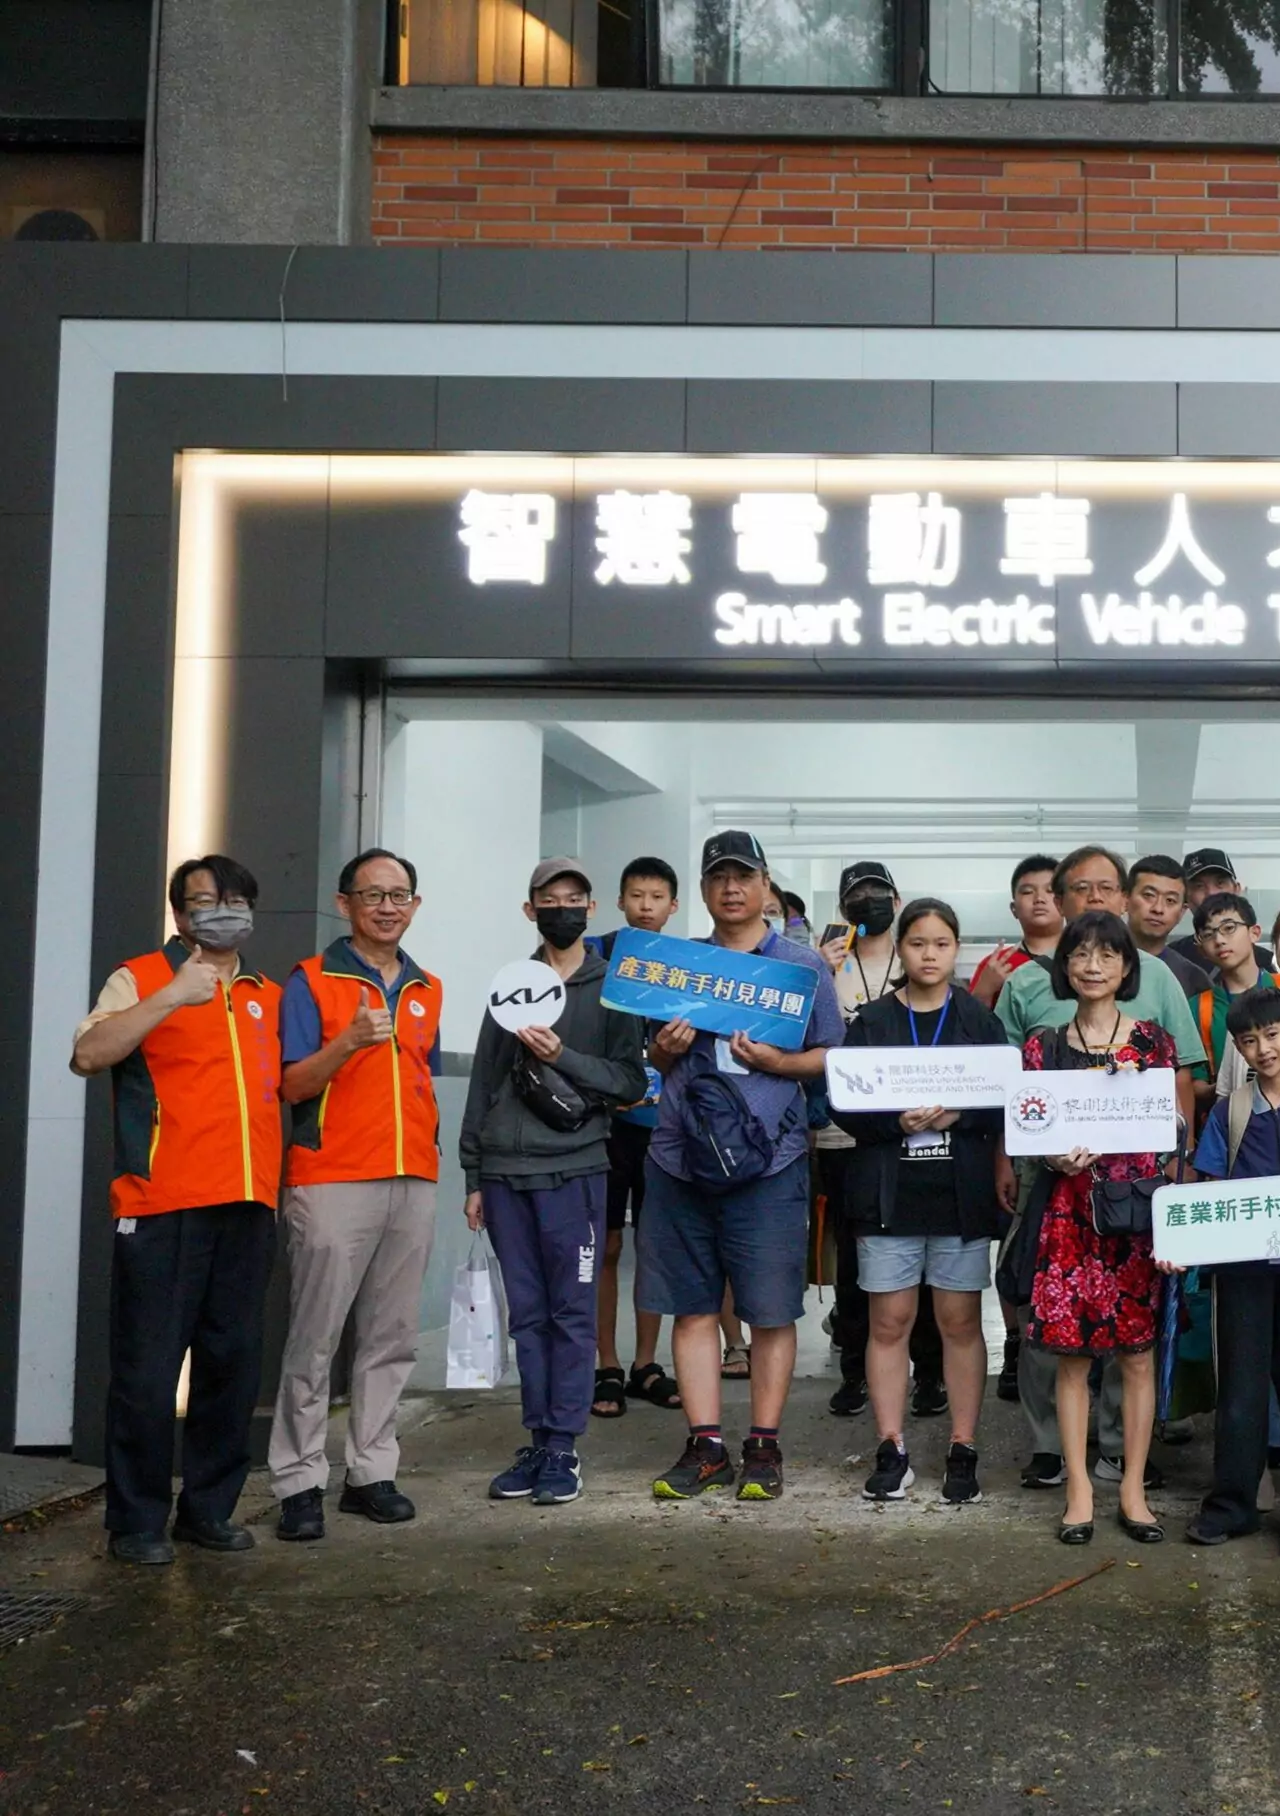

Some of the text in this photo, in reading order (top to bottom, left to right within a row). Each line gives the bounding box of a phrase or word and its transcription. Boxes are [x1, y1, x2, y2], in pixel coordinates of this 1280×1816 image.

[714, 592, 861, 646] Smart
[882, 592, 1056, 647] Electric
[1081, 592, 1245, 647] Vehicle
[616, 955, 806, 1017] 產業新手村見學團
[491, 984, 562, 1008] KIA
[888, 1064, 966, 1076] 龍華科技大學
[905, 1086, 942, 1094] SCIENCE
[945, 1085, 964, 1093] AND
[936, 1076, 986, 1085] UNIVERSITY
[1061, 1095, 1174, 1114] 黎明技術學院
[1135, 1114, 1174, 1122] Technology
[578, 1245, 595, 1283] NIKE
